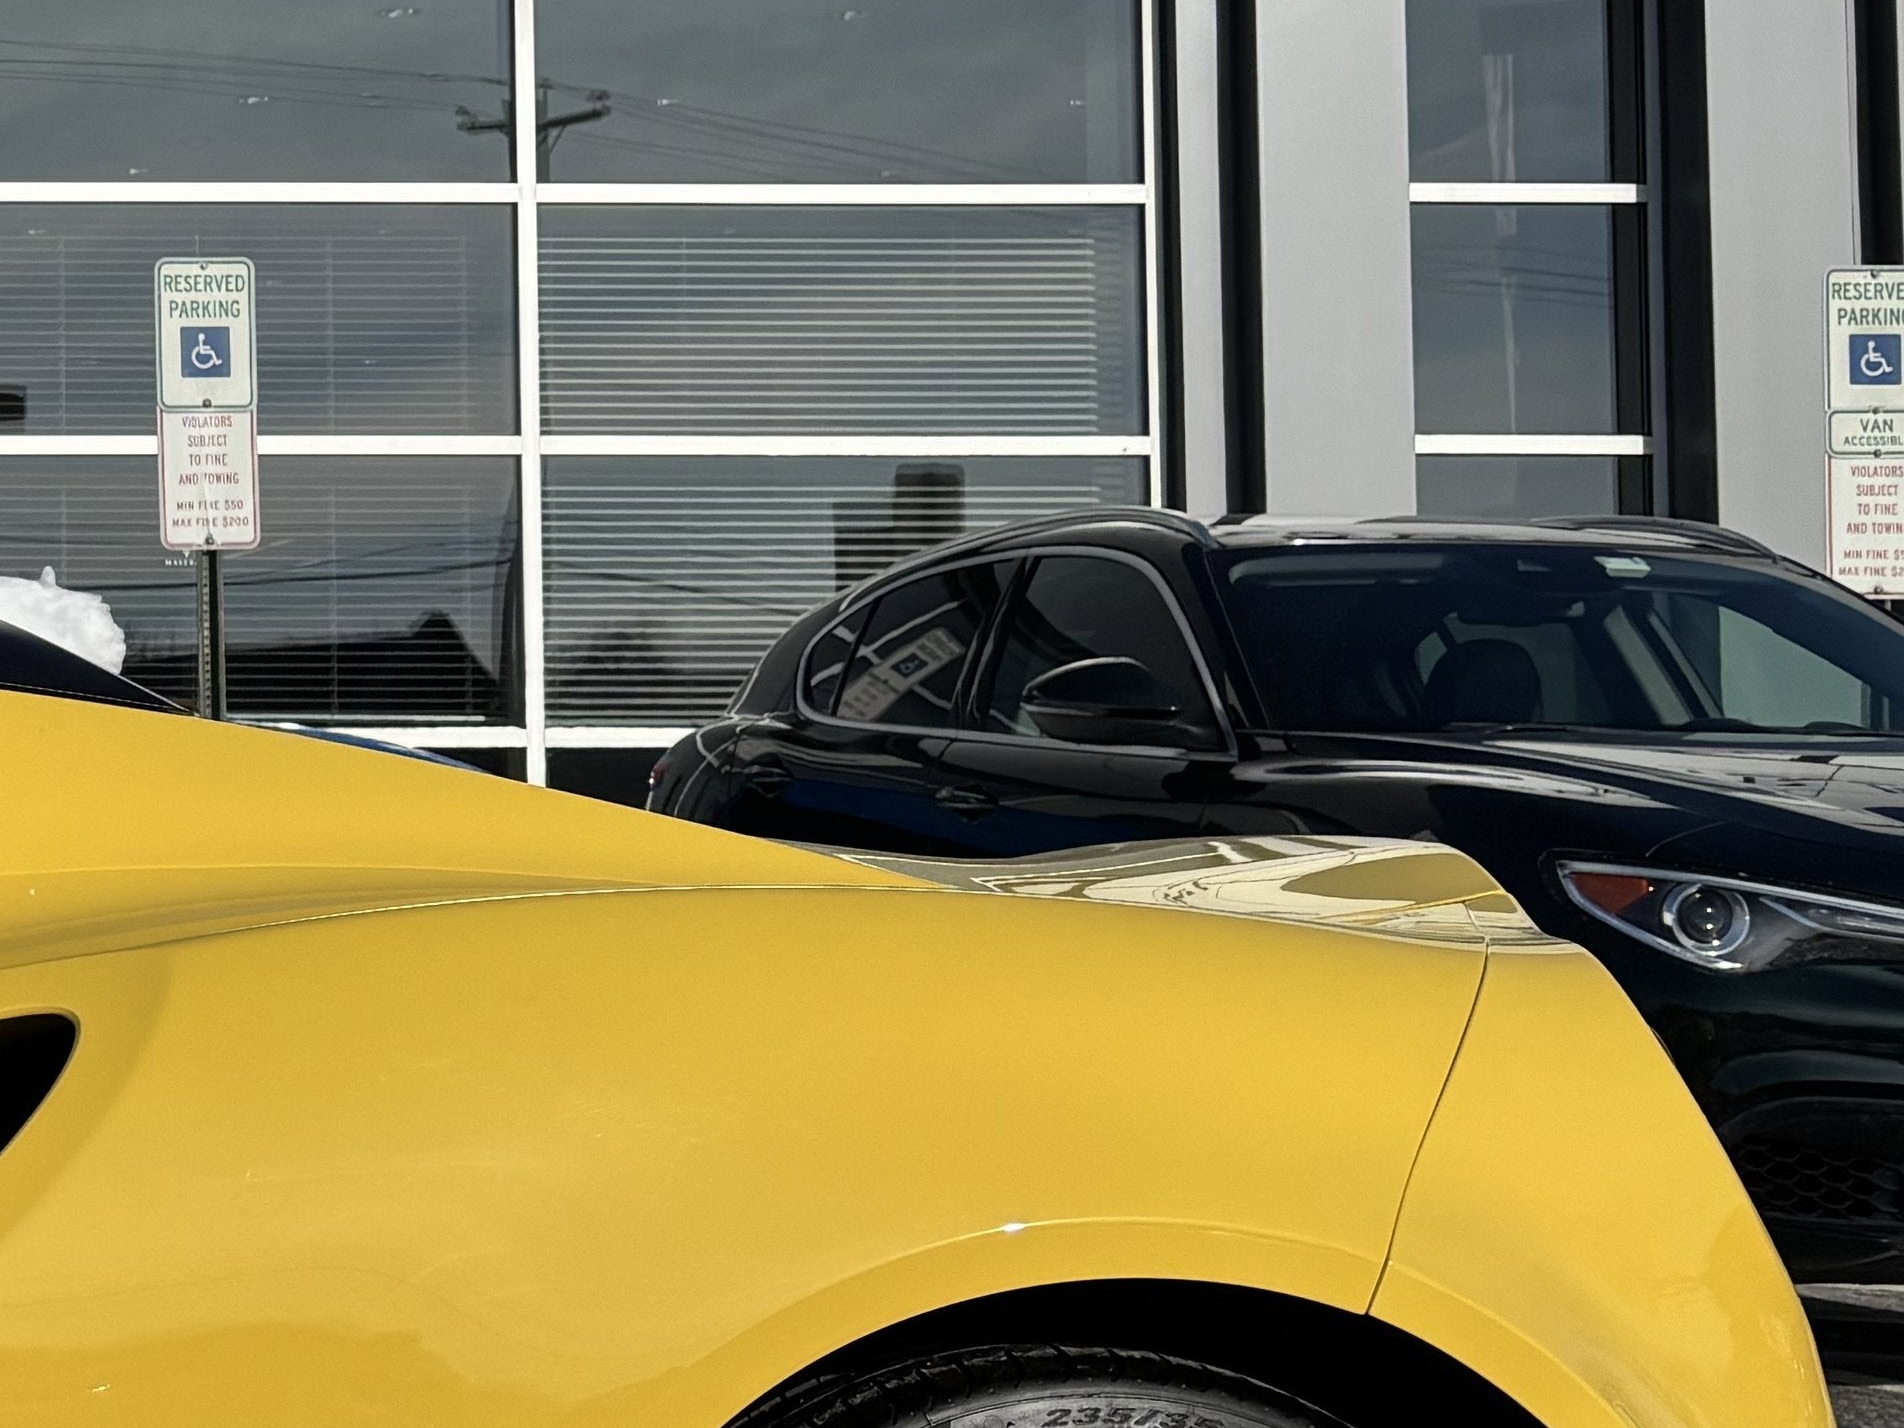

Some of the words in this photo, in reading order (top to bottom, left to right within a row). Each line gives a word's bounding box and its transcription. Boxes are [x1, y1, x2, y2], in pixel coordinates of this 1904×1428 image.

[163, 274, 245, 293] RESERVED
[1832, 281, 1904, 301] RESERVE
[169, 300, 241, 319] PARKING
[1837, 308, 1904, 326] PARKIN
[182, 415, 233, 429] VIOLATORS
[1859, 417, 1894, 433] VAN
[187, 434, 228, 448] SUBJECT
[189, 454, 201, 466] TO
[1850, 465, 1904, 478] VIOLATORS
[179, 473, 199, 485] AND
[204, 472, 239, 485] TOWING
[1856, 484, 1899, 497] SUBJECT
[224, 499, 244, 511] $50
[1857, 503, 1870, 516] TO
[1874, 503, 1898, 516] FINE
[222, 515, 249, 528] $200
[1846, 522, 1868, 535] AND
[1843, 549, 1863, 560] MIN
[1866, 549, 1889, 560] FINE
[164, 559, 197, 567] MASER
[1838, 566, 1859, 576] MAX
[1864, 566, 1887, 577] FINE
